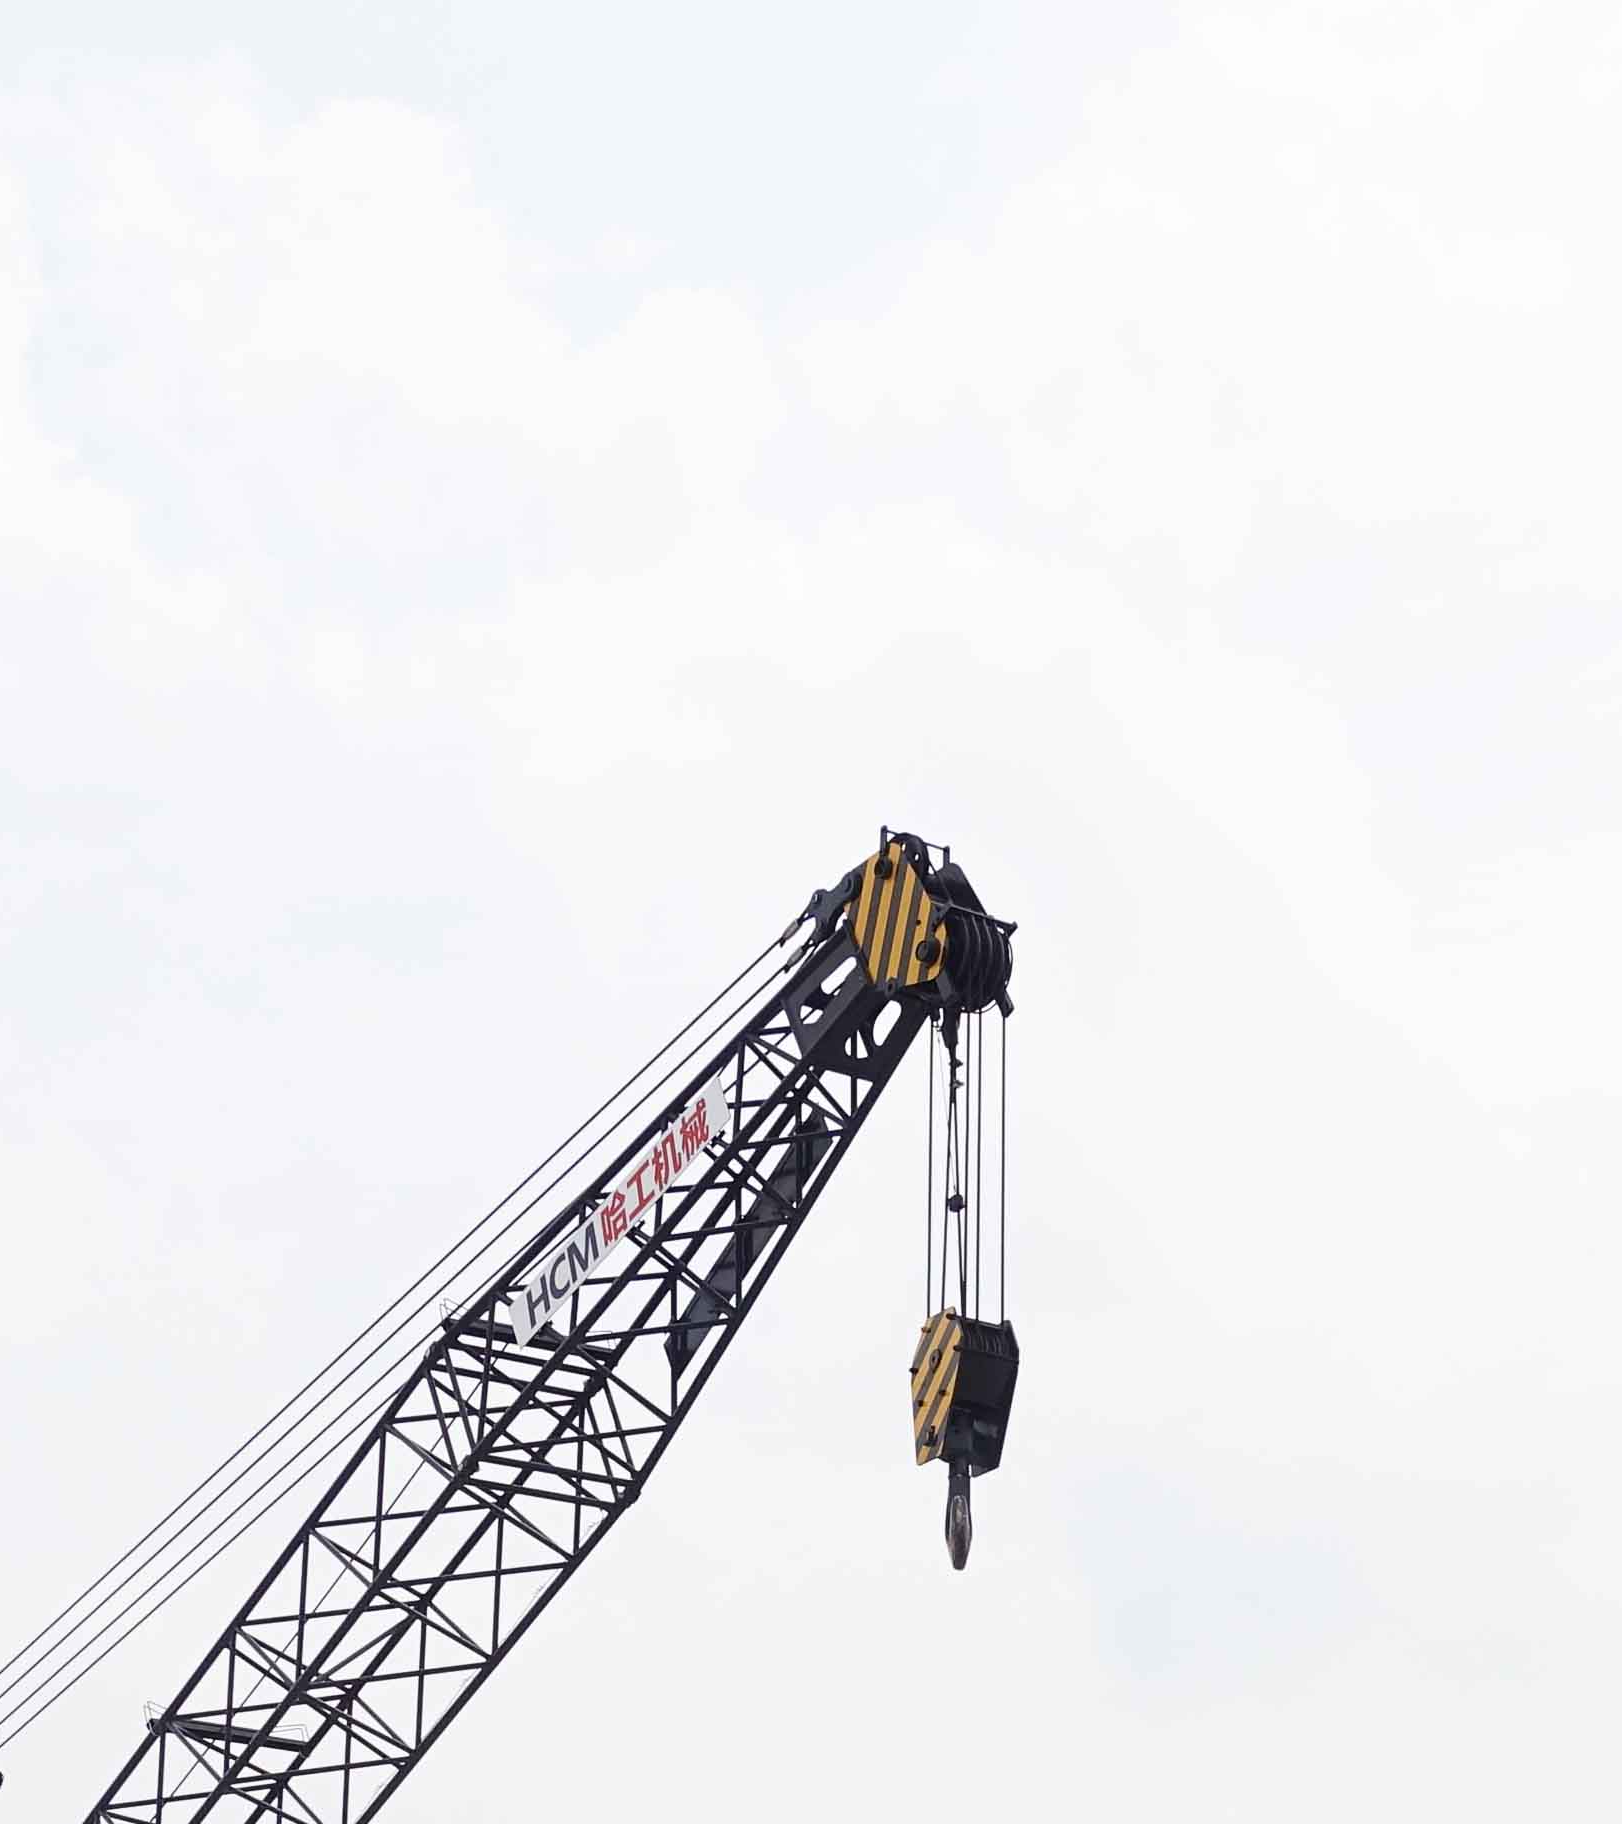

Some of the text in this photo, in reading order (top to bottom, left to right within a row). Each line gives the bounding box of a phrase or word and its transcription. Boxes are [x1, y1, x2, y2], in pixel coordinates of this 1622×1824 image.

[525, 1097, 710, 1330] HCM 哈工机械
